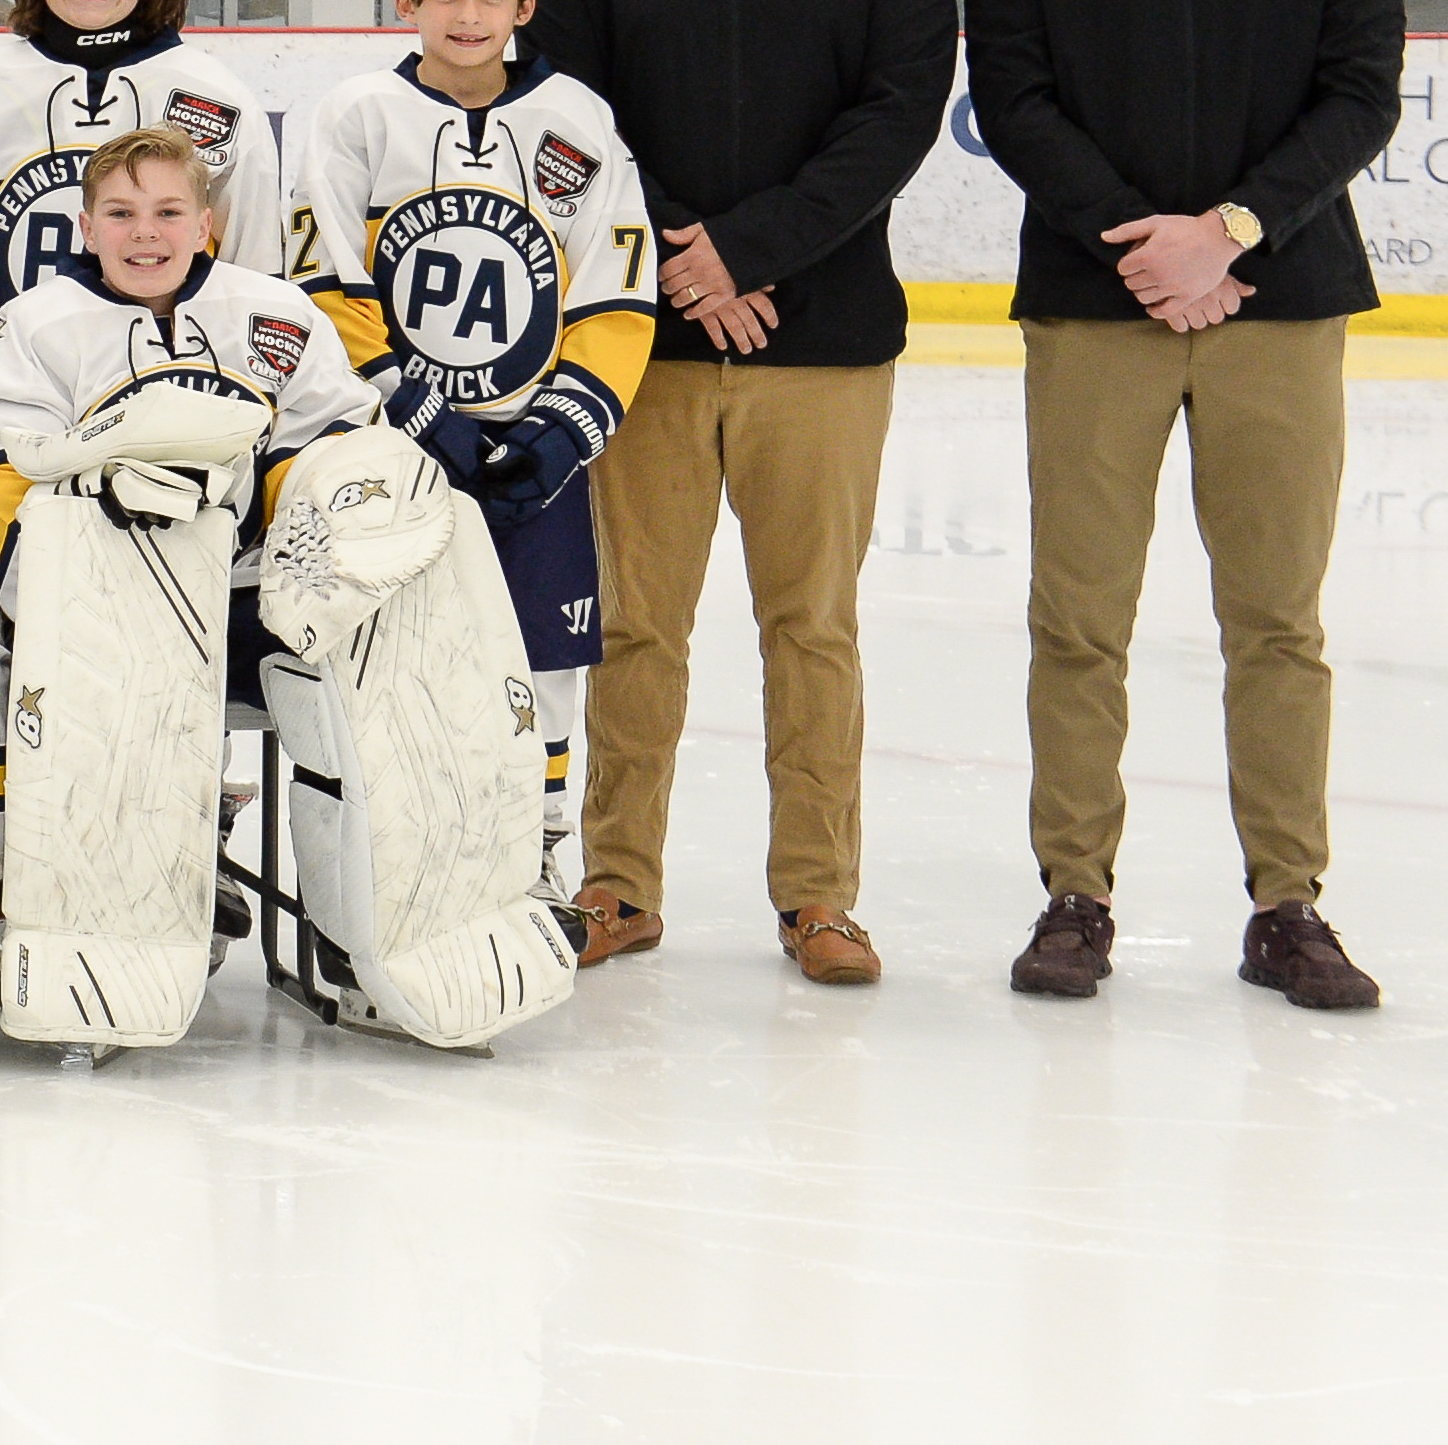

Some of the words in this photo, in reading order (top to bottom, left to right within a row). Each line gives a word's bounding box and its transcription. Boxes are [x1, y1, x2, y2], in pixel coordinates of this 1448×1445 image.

[76, 30, 131, 46] CCM
[169, 107, 231, 134] HOCKEY
[537, 151, 586, 186] HOCKEY
[290, 205, 321, 280] 2
[379, 194, 557, 292] PENNSYLVANIA
[611, 224, 648, 293] 7
[1367, 240, 1432, 266] ARD
[405, 246, 509, 345] PA
[405, 354, 502, 398] BRICK
[532, 393, 605, 455] WARRIOR
